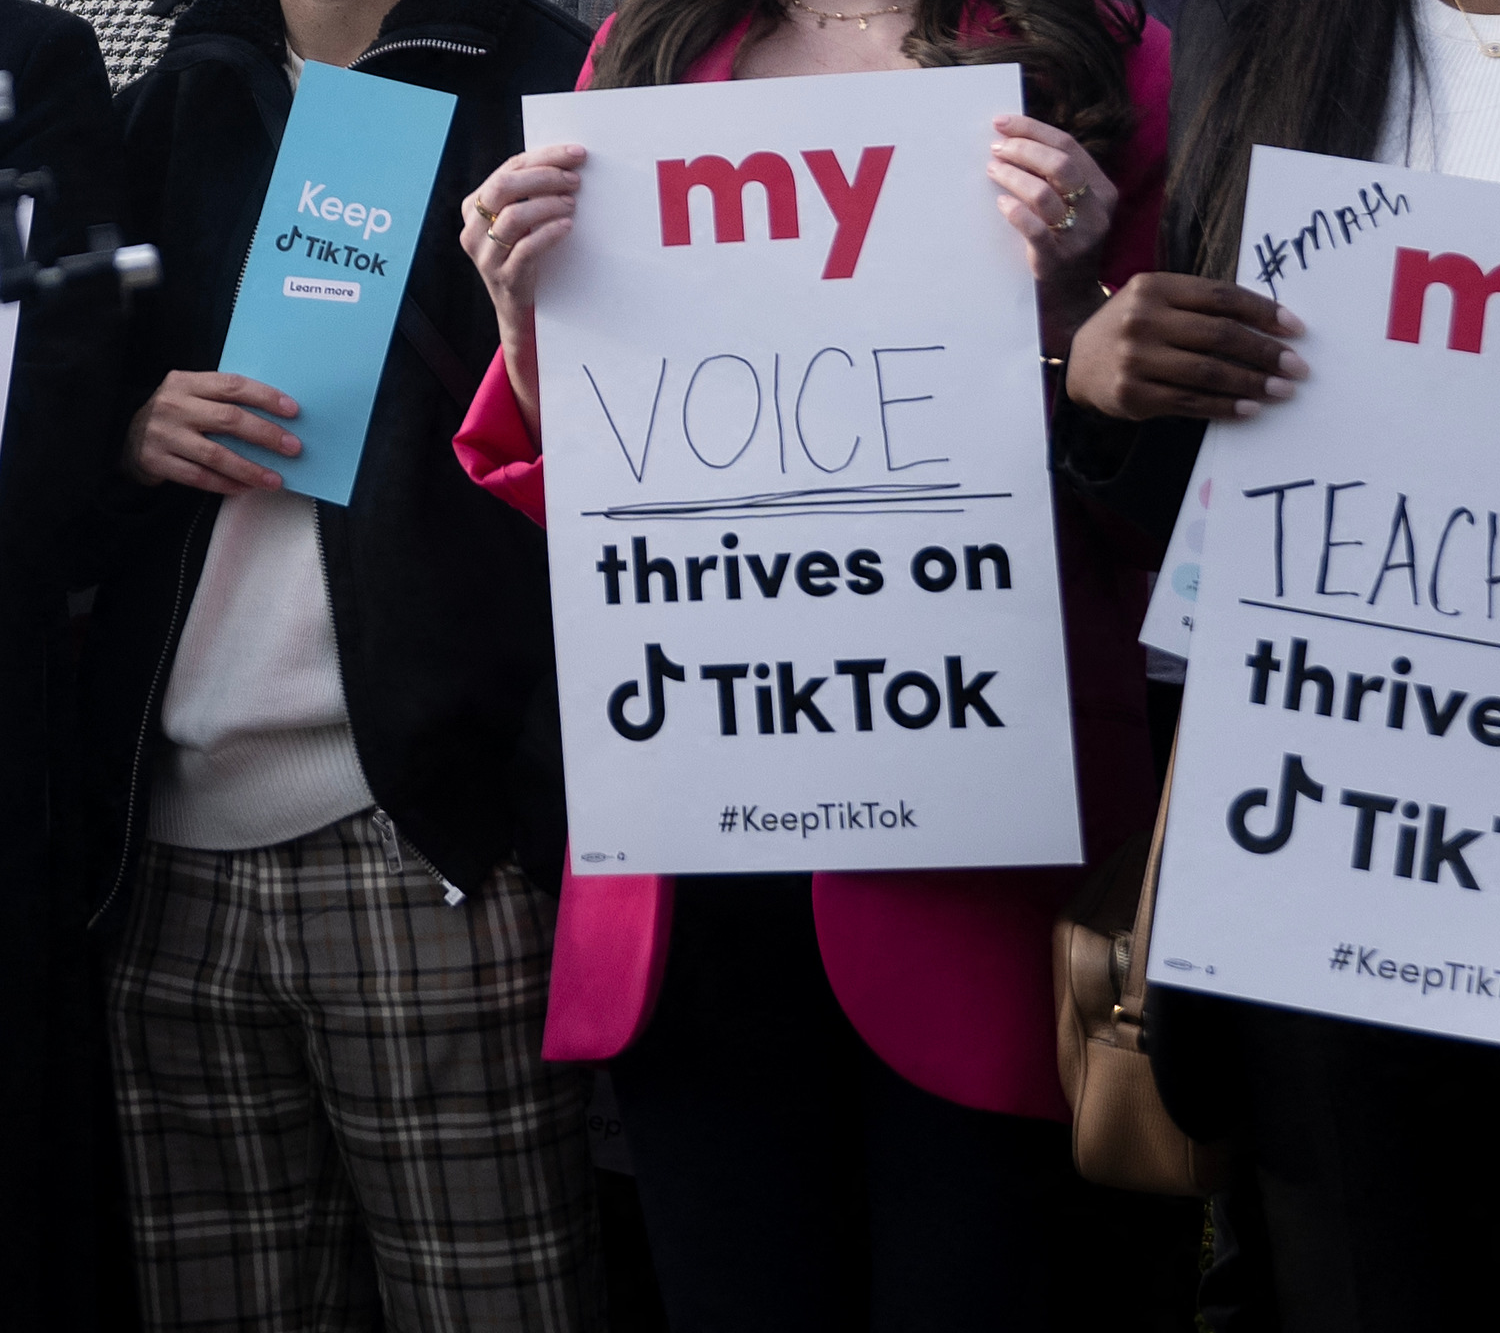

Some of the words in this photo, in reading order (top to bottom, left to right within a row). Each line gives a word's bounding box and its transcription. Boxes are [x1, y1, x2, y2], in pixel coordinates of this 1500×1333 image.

[298, 181, 391, 240] Keep
[658, 148, 893, 279] my
[307, 236, 386, 276] TikTok
[290, 282, 321, 294] Learn
[324, 287, 354, 297] more
[581, 346, 951, 482] VOICE
[597, 533, 884, 604] thrives
[912, 544, 1011, 592] on
[701, 656, 1004, 735] TikTok
[720, 801, 916, 838] #KeepTikTok
